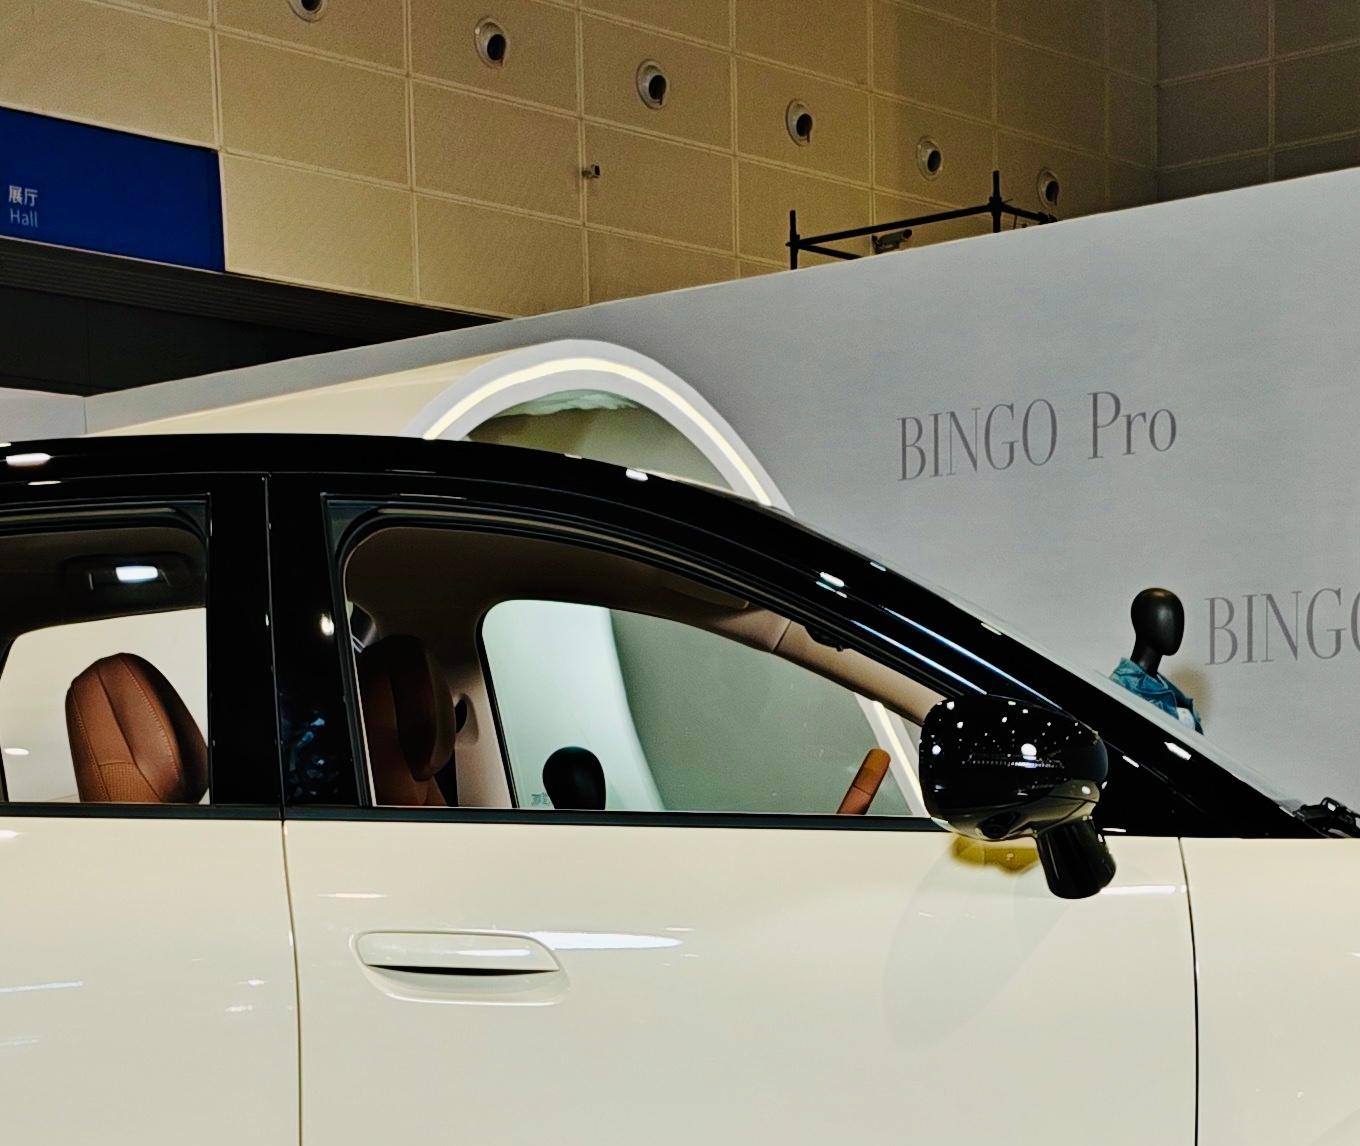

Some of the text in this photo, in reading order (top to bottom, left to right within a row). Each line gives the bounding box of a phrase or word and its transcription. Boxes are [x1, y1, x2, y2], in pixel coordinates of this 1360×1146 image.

[8, 185, 39, 207] 展厅
[10, 208, 39, 228] Hall
[896, 390, 1177, 482] BINGO Pro
